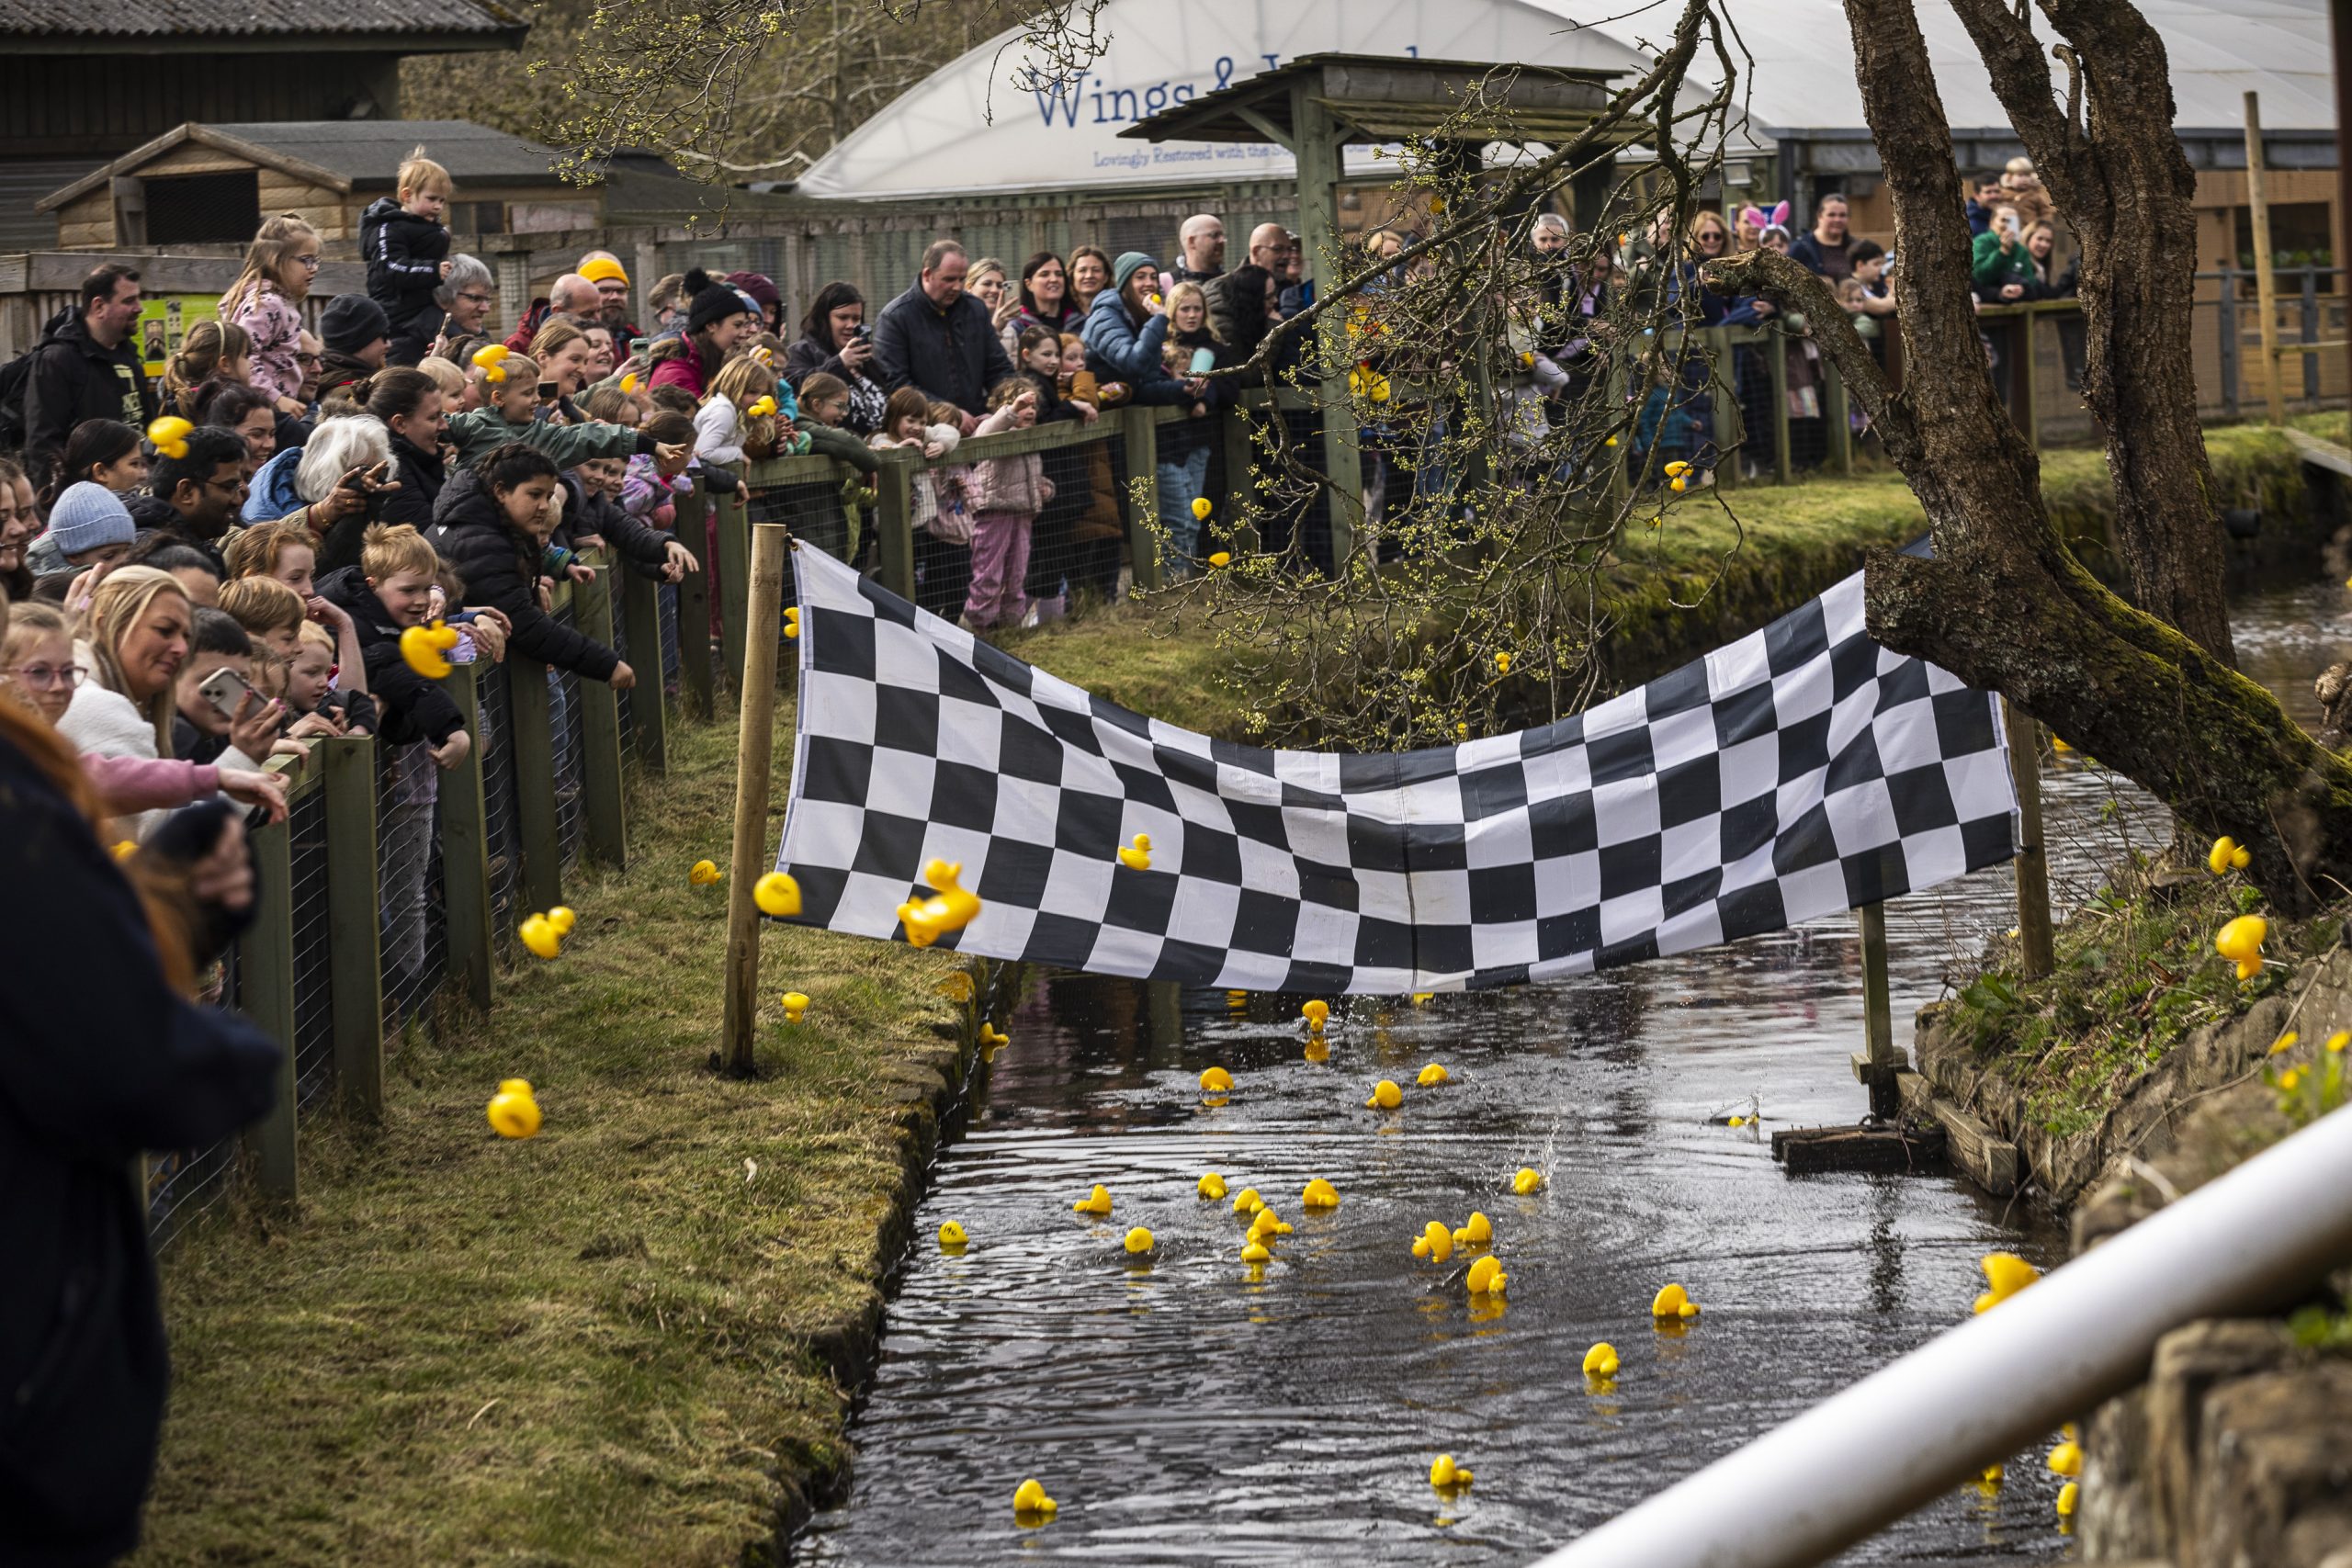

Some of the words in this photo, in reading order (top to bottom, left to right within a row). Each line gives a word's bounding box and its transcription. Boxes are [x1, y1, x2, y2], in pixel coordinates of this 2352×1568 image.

[1026, 71, 1194, 129] Wings
[1093, 148, 1149, 169] Lovingly
[1153, 146, 1212, 163] Restored
[1215, 142, 1245, 160] with
